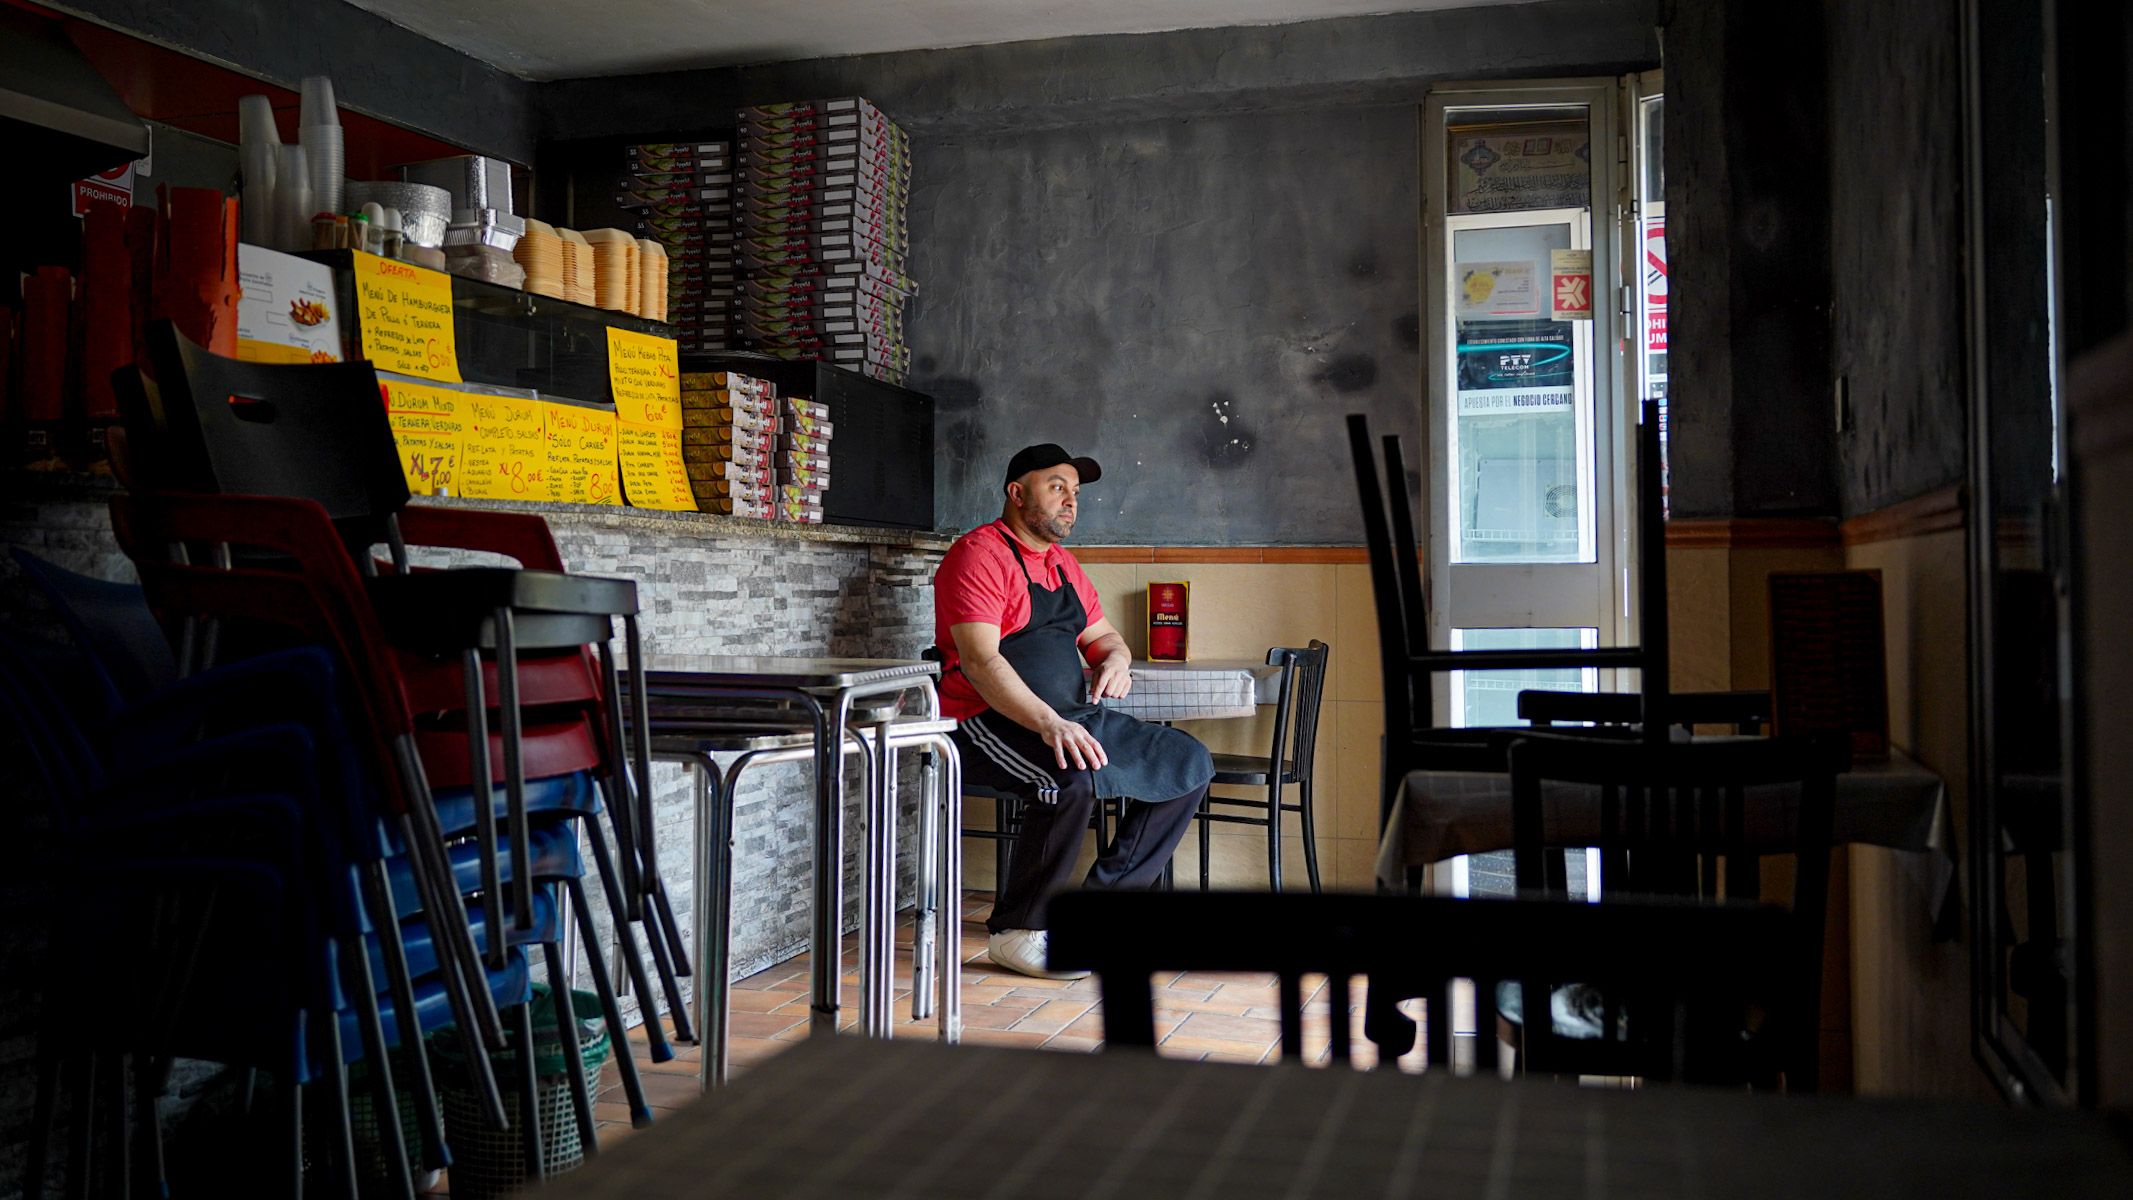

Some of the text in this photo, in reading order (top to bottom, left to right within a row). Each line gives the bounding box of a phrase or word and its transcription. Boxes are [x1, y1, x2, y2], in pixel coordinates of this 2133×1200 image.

[80, 186, 128, 207] PROHIBIDO
[380, 261, 417, 280] OFERTA
[388, 289, 398, 304] DE
[365, 307, 377, 320] DE
[1500, 355, 1531, 365] PTV
[659, 363, 675, 379] XL
[1464, 396, 1490, 409] APUESTA
[1491, 396, 1503, 408] POR
[1513, 394, 1541, 406] NEGOCIO
[1542, 393, 1572, 405] CERCANO
